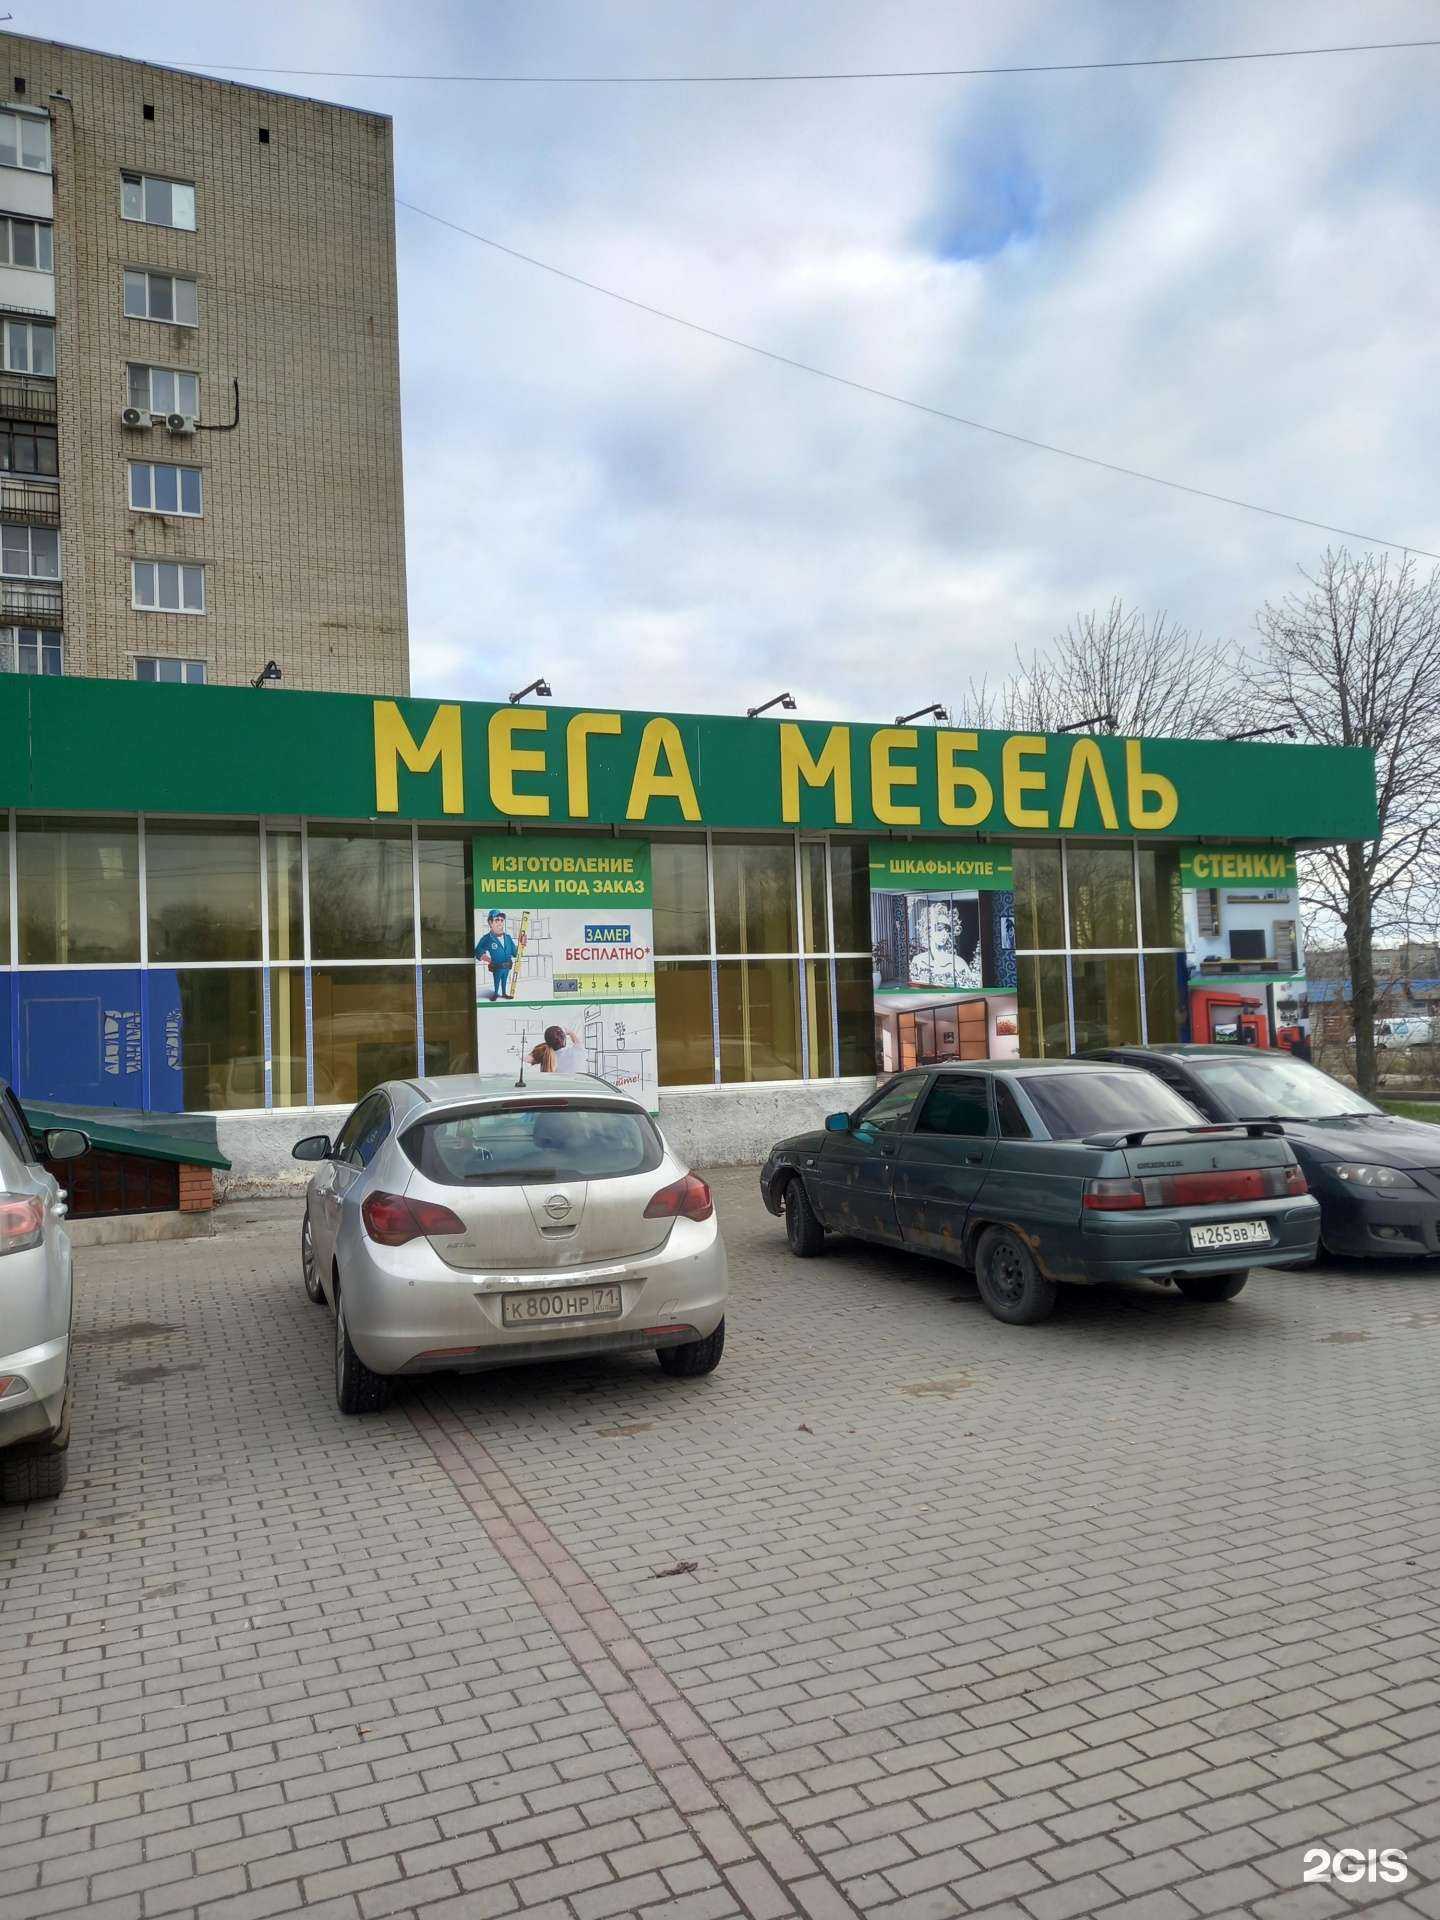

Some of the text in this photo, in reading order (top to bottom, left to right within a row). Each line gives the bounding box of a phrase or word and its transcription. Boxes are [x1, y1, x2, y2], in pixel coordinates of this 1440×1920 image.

[373, 700, 1179, 830] МЕГА МЕБЕЛЬ
[491, 856, 634, 873] ИЗГОТОВЛЕНИЕ
[889, 859, 994, 876] ШКАФЫ-КУПЕ
[1193, 854, 1287, 878] СТЕНКИ
[481, 879, 645, 895] МЕБЕЛИ ПОД ЗАКАЗ
[585, 928, 630, 942] ЗАМЕР
